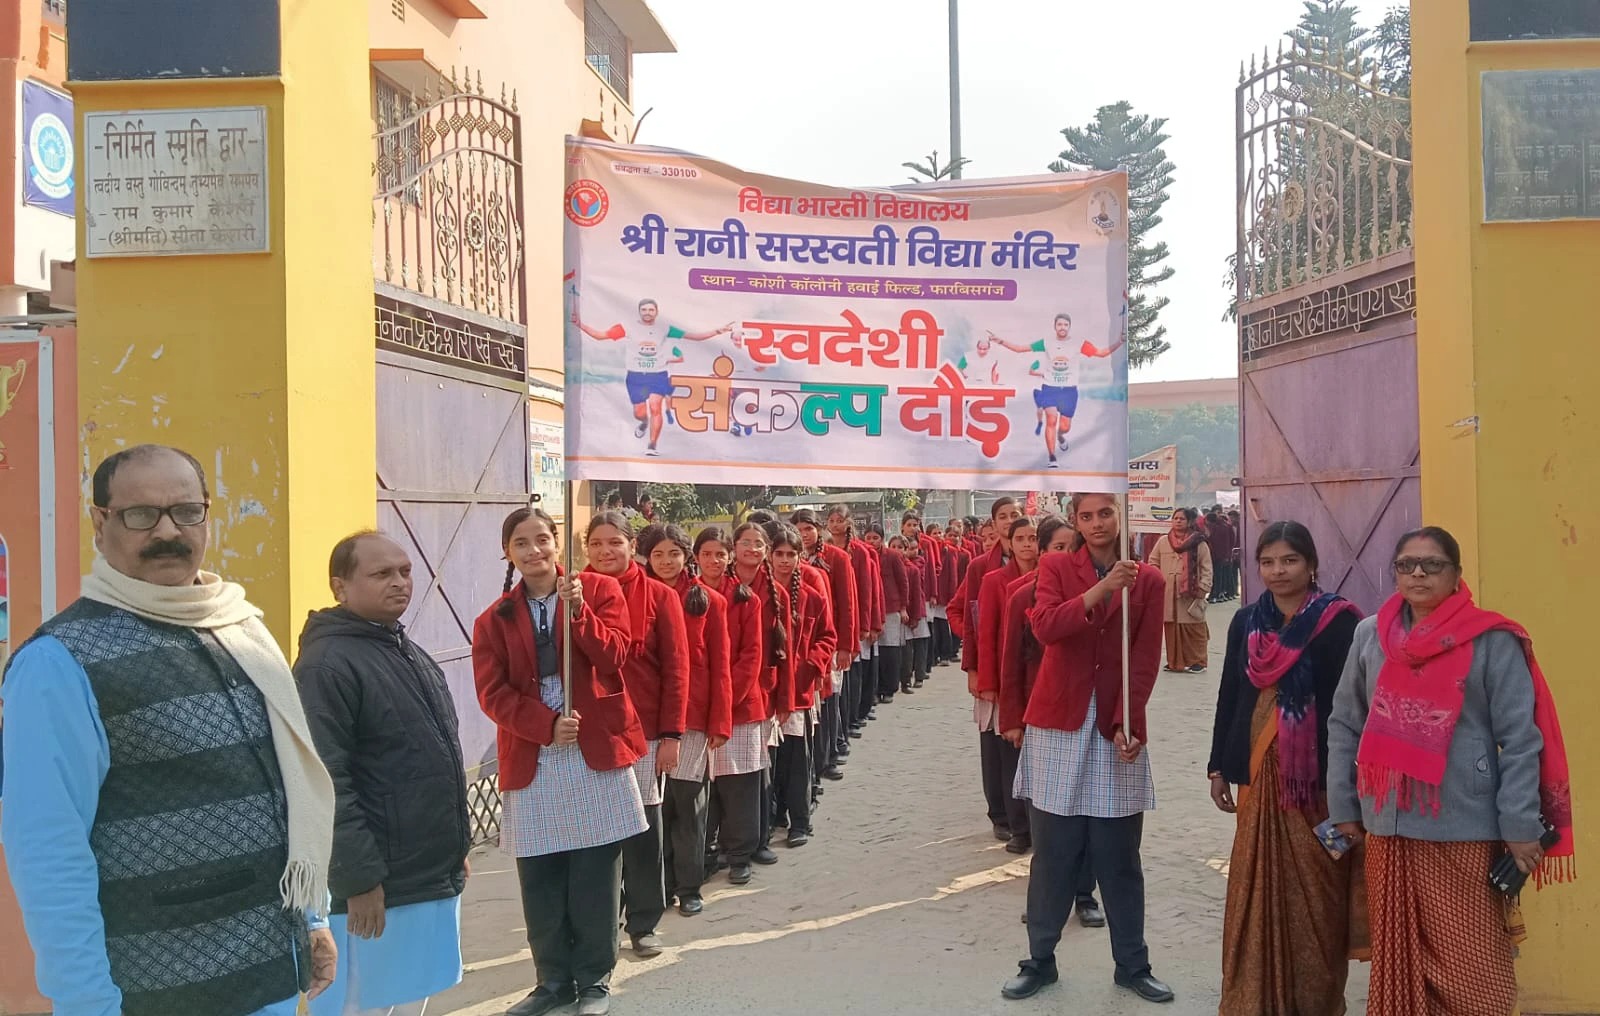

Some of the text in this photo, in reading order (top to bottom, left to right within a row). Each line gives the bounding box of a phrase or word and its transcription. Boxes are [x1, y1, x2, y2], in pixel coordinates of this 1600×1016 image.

[166, 118, 208, 165] स्मृति
[94, 172, 120, 196] त्वदीय
[126, 176, 144, 199] वस्तु
[149, 170, 188, 197] गोविन्दम्
[662, 166, 697, 179] 330100
[112, 206, 138, 220] राम
[152, 205, 194, 224] कुमार
[738, 186, 969, 222] विद्या भारती विद्यालय
[170, 226, 205, 243] सीता
[620, 214, 1080, 270] श्री रानी सरस्वती विद्या मंदिर
[700, 273, 1006, 296] स्थान- कोशी कॉलौनी हवाई फिल्ड, फारबिसगंज
[1331, 285, 1348, 329] की
[1348, 286, 1384, 332] पुण्य
[742, 308, 944, 370] स्वदेशी
[670, 355, 1016, 458] संकल्प दौड़
[1129, 460, 1159, 470] वास
